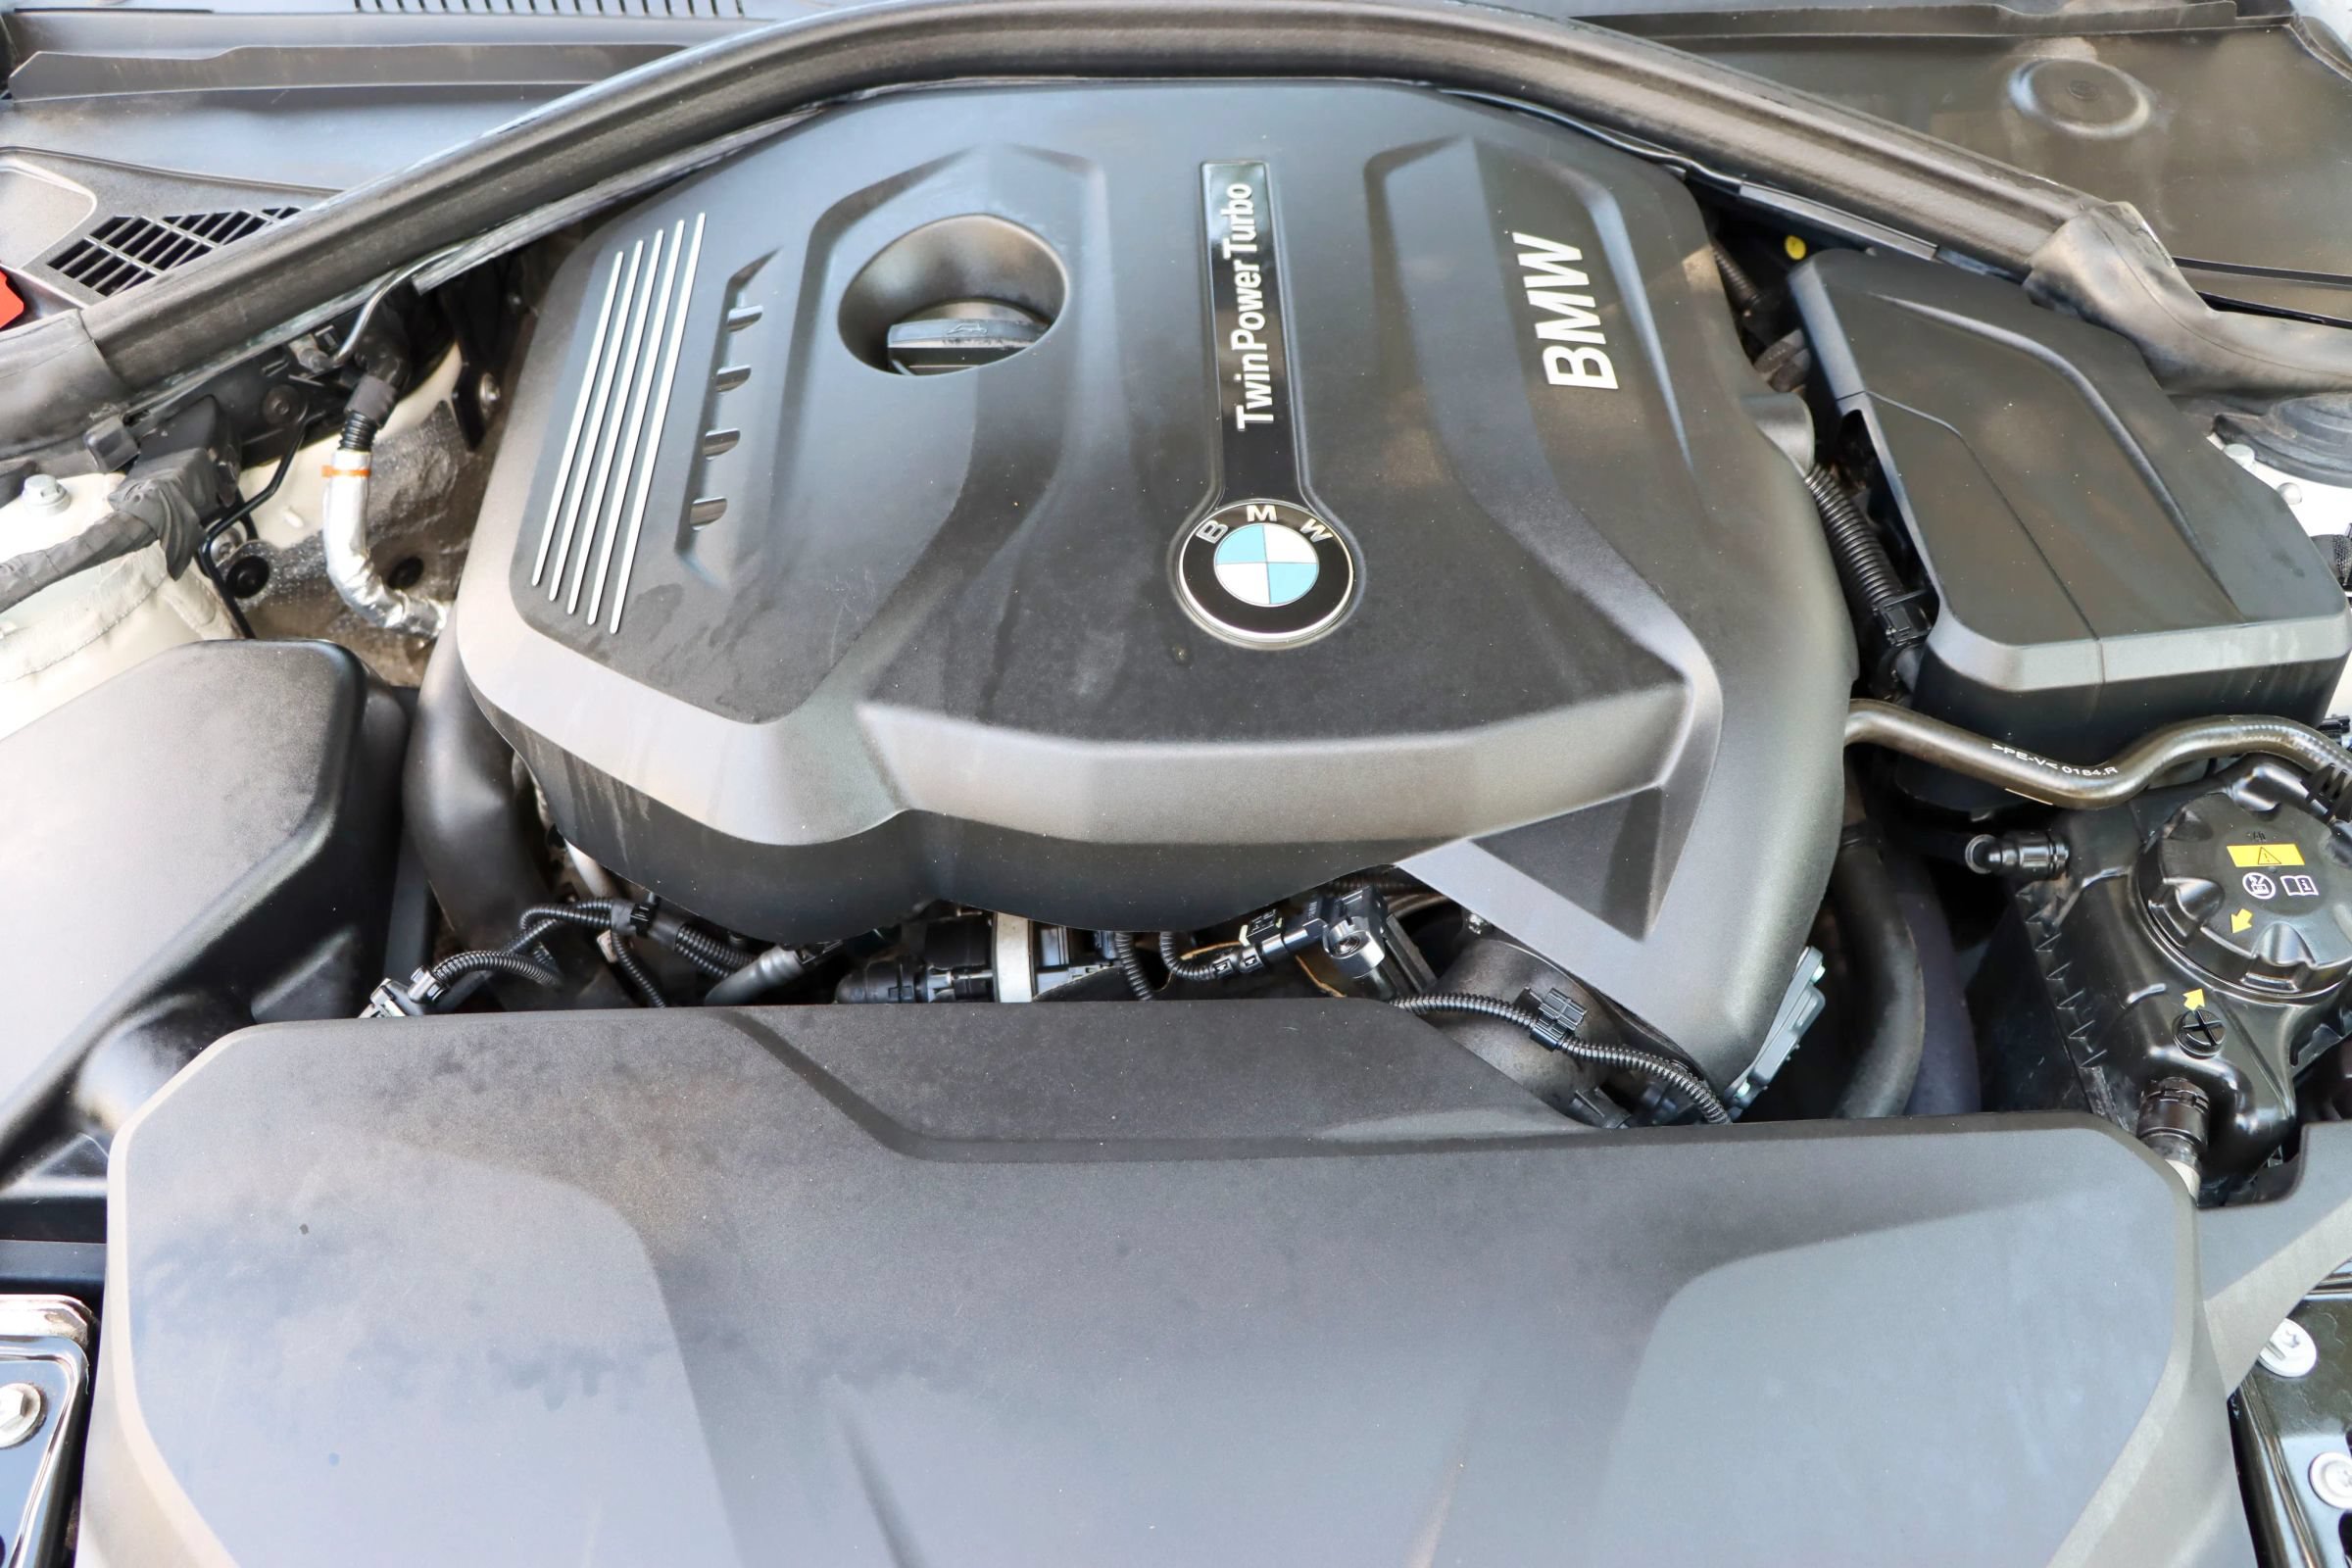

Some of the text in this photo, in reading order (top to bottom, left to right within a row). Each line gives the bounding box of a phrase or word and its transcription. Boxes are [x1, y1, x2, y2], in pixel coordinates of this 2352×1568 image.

[1220, 182, 1274, 431] TwinPower Turbo
[1511, 231, 1619, 389] BMW
[1196, 504, 1334, 545] BMW
